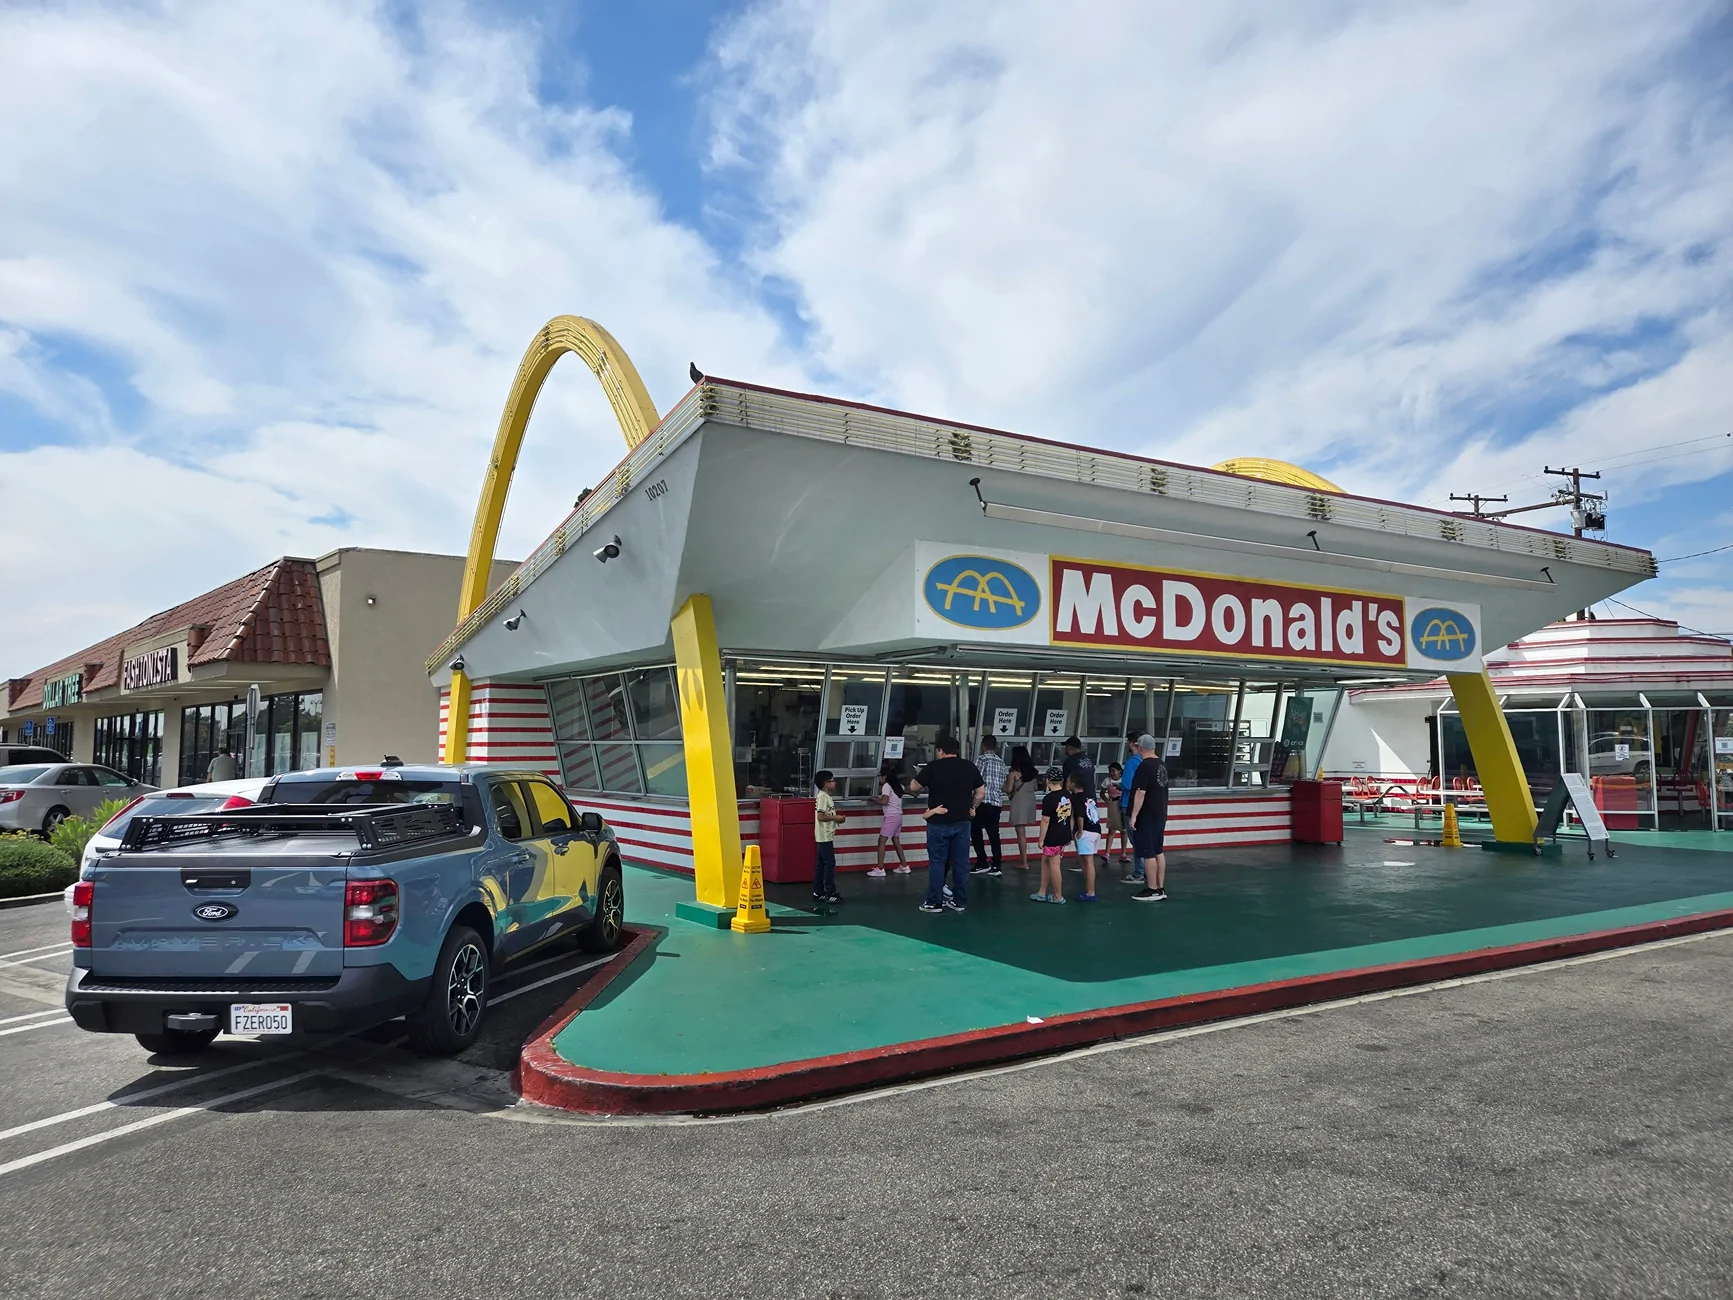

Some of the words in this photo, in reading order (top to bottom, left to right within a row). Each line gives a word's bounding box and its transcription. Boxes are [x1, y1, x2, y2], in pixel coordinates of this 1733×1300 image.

[645, 479, 668, 501] 10207
[1056, 568, 1401, 657] McDonald's
[124, 648, 172, 690] FASHIONISTA
[43, 680, 63, 710] DOLLAR
[64, 674, 80, 706] TREE
[202, 907, 223, 916] Ford
